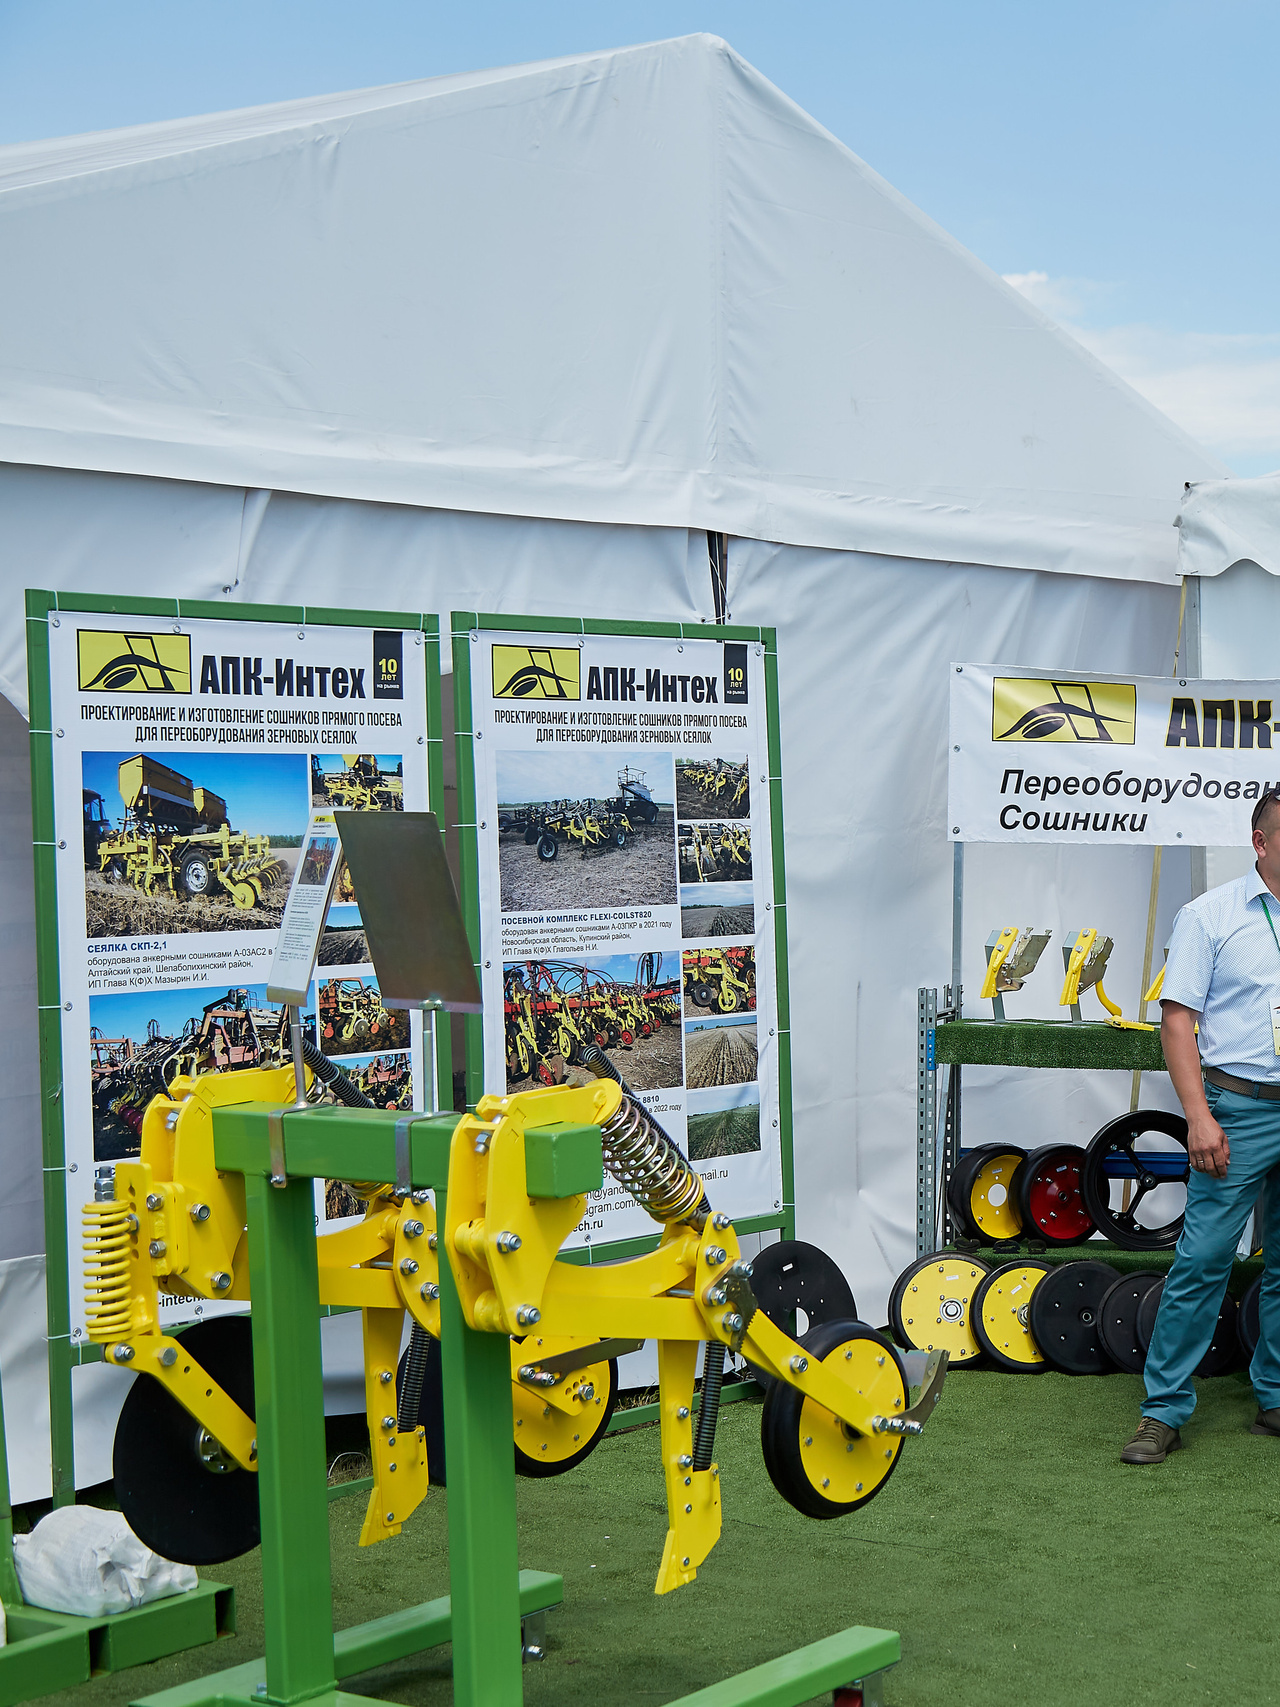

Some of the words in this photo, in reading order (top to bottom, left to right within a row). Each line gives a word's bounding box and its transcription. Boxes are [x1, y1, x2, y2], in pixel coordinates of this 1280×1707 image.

[379, 658, 397, 673] 10
[200, 655, 366, 698] АПК-Интех
[728, 668, 743, 681] 10
[587, 666, 718, 704] АПК-Интех
[81, 705, 176, 722] ПРОЕКТИРОВАНИЕ
[178, 707, 186, 721] И
[188, 707, 265, 724] ИЗГОТОВЛЕНИЕ
[267, 709, 320, 725] СОШНИКОВ
[322, 711, 365, 726] ПРЯМОГО
[367, 712, 403, 727] ПОСЕВА
[494, 710, 569, 725] ПРОЕКТИРОВАНИЕ
[570, 711, 576, 725] И
[577, 712, 637, 726] ИЗГОТОВЛЕНИЕ
[639, 713, 682, 727] СОШНИКОВ
[683, 714, 718, 728] ПРЯМОГО
[719, 715, 748, 728] ПОСЕВА
[135, 726, 158, 743] ДЛЯ
[160, 727, 265, 744] ПЕРЕОБОРУДОВАНИЯ
[267, 729, 319, 744] ЗЕРНОВЫХ
[321, 730, 358, 745] СЕЯЛОК
[536, 729, 554, 743] ДЛЯ
[555, 729, 638, 744] ПЕРЕОБОРУДОВАНИЯ
[639, 730, 682, 744] ЗЕРНОВЫХ
[683, 731, 712, 744] СЕЯЛОК
[999, 804, 1148, 832] Сошники
[501, 915, 544, 925] ПОСЕВНОЙ
[546, 913, 588, 923] КОМПЛЕКС
[501, 928, 538, 937] оборудован
[539, 926, 574, 936] анкерными
[575, 924, 610, 933] сошниками
[644, 921, 658, 929] 2021
[659, 921, 672, 929] году
[87, 943, 128, 953] СЕЯЛКА
[130, 941, 167, 952] СКП-2,1
[501, 937, 550, 948] Новосибирская
[551, 935, 577, 944] область,
[578, 932, 611, 943] Купинский
[87, 955, 141, 967] оборудована
[142, 953, 187, 964] анкерными
[188, 951, 232, 960] сошниками
[502, 948, 513, 956] ИП
[513, 947, 532, 956] Глава
[533, 946, 552, 955] К(Ф)Х
[87, 966, 132, 978] Алтайский
[133, 965, 154, 976] край,
[155, 961, 227, 973] Шелаболихинский
[88, 979, 101, 988] ИП
[103, 977, 127, 988] Глава
[129, 976, 153, 988] К(Ф)Х
[154, 974, 191, 986] Мазырин
[192, 972, 210, 982] И.И.
[642, 1095, 660, 1104] 8810
[669, 1104, 682, 1112] году
[699, 1168, 729, 1182] mail.ru
